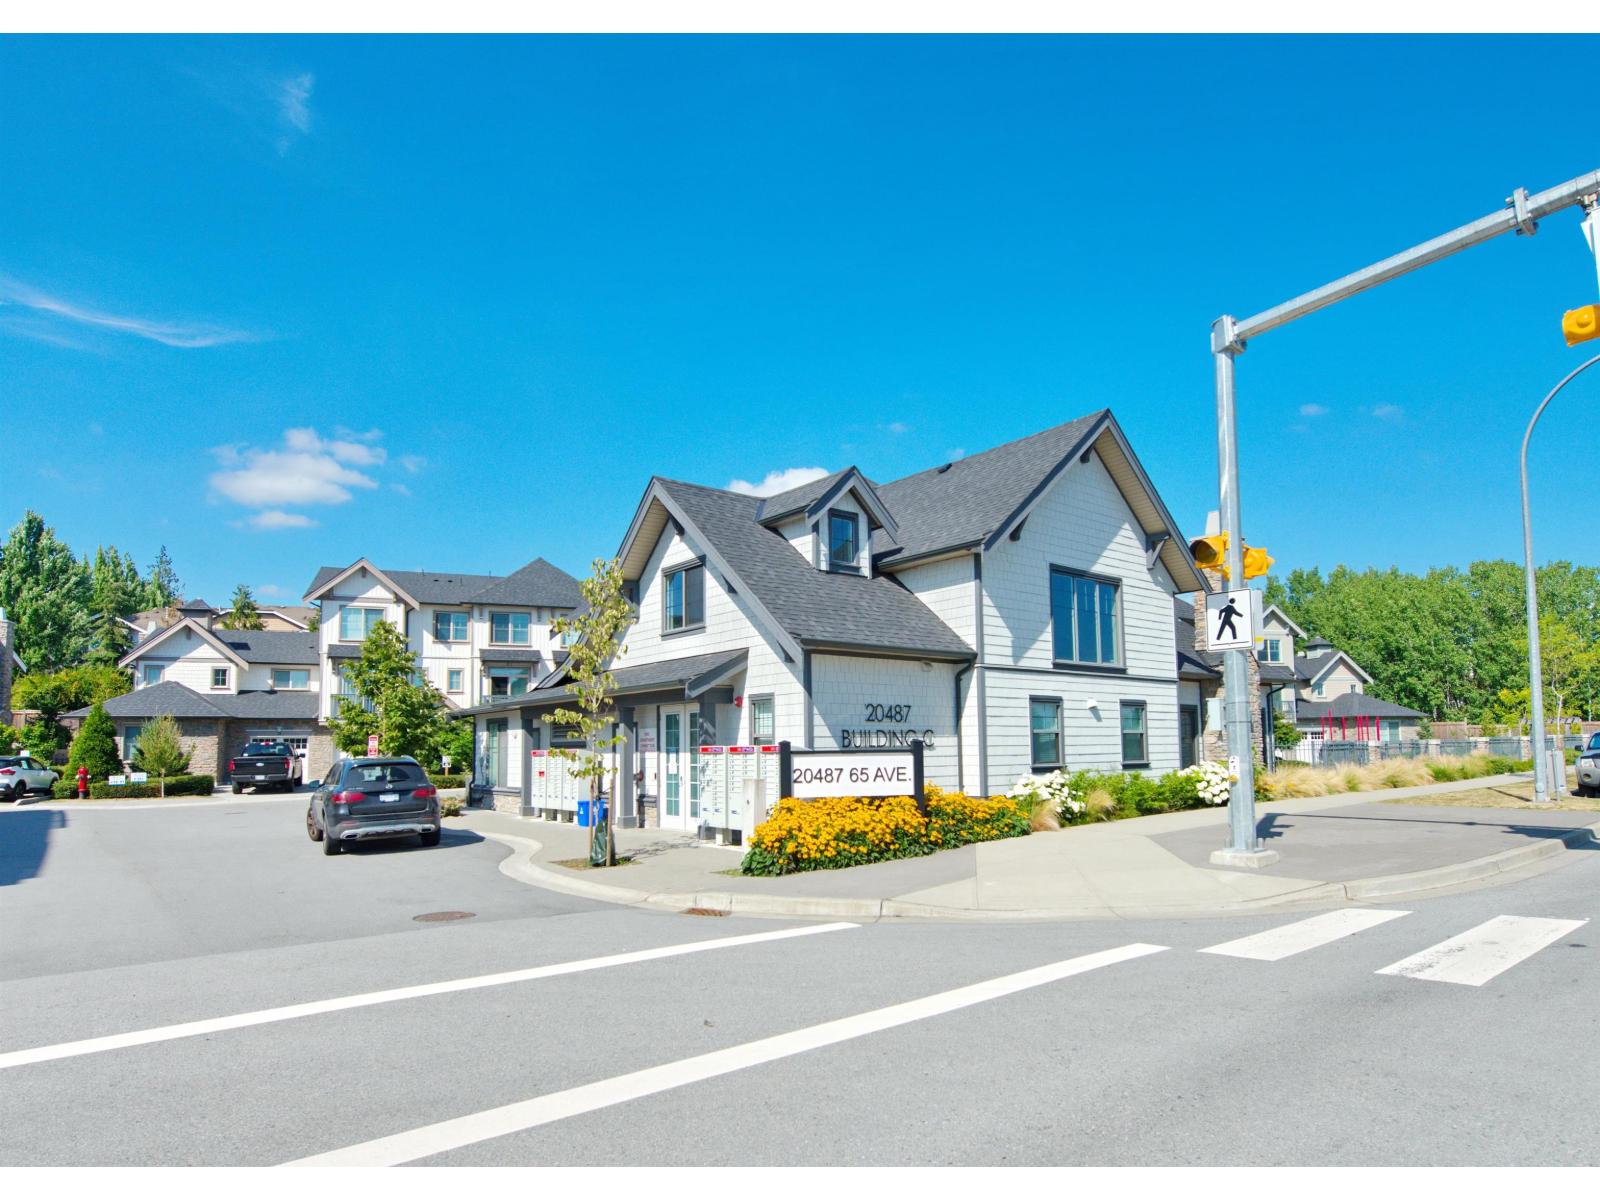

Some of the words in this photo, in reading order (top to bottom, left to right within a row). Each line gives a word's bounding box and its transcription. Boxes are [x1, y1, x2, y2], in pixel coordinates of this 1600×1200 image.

[865, 703, 912, 723] 20487
[842, 729, 916, 748] BUILDING
[923, 729, 935, 748] C
[793, 768, 844, 784] 20487
[849, 767, 870, 783] 65
[873, 767, 912, 783] AVE.
